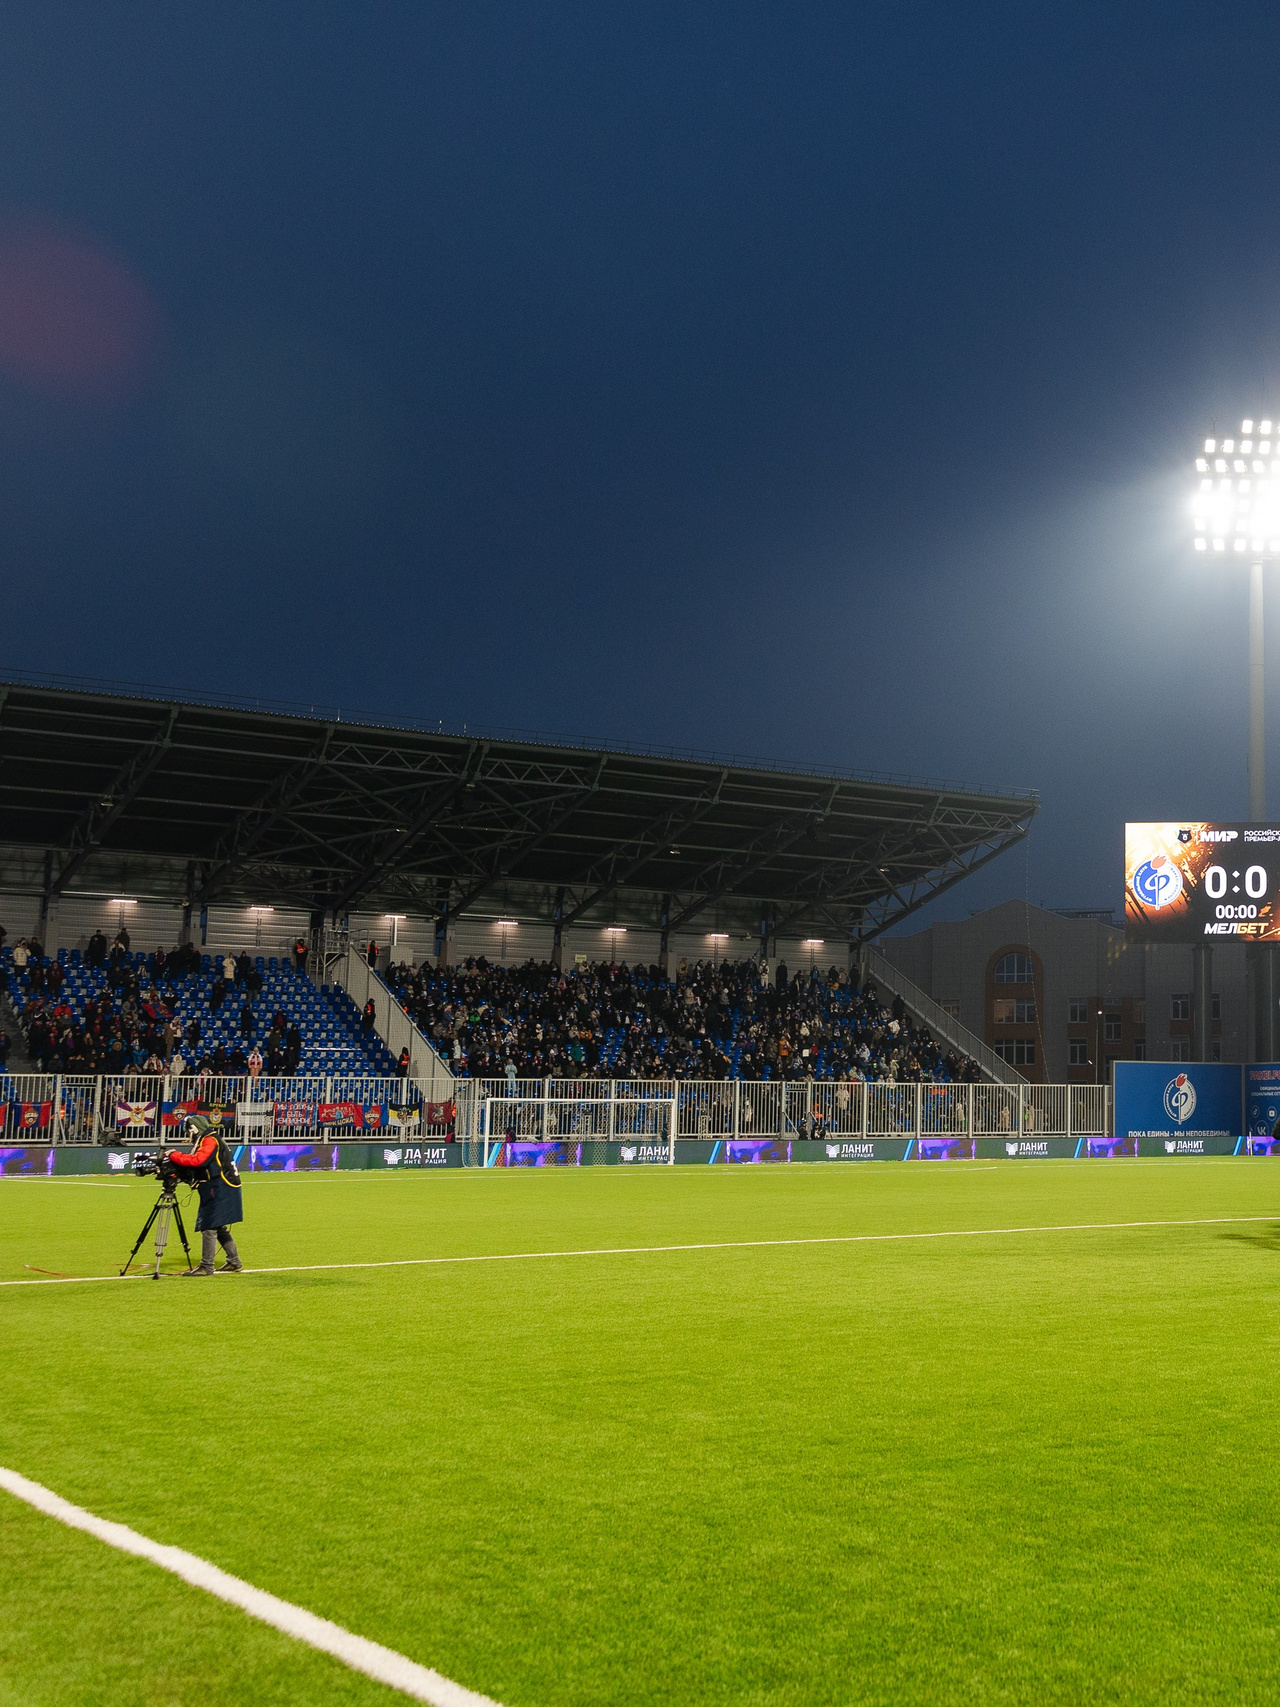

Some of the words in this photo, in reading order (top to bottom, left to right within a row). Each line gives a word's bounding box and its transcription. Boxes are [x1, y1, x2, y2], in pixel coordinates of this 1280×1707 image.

[1200, 831, 1239, 842] МИР
[1205, 865, 1267, 899] 0:0
[1215, 904, 1257, 919] 00:00
[1204, 922, 1269, 934] МЕЛБЕТ
[1128, 1130, 1146, 1138] ПОКА
[841, 1144, 874, 1153] ЛАНИТ
[1019, 1142, 1048, 1151] ЛАНИТ
[1177, 1140, 1204, 1149] ЛАНИТ
[638, 1146, 675, 1156] ЛАНИ
